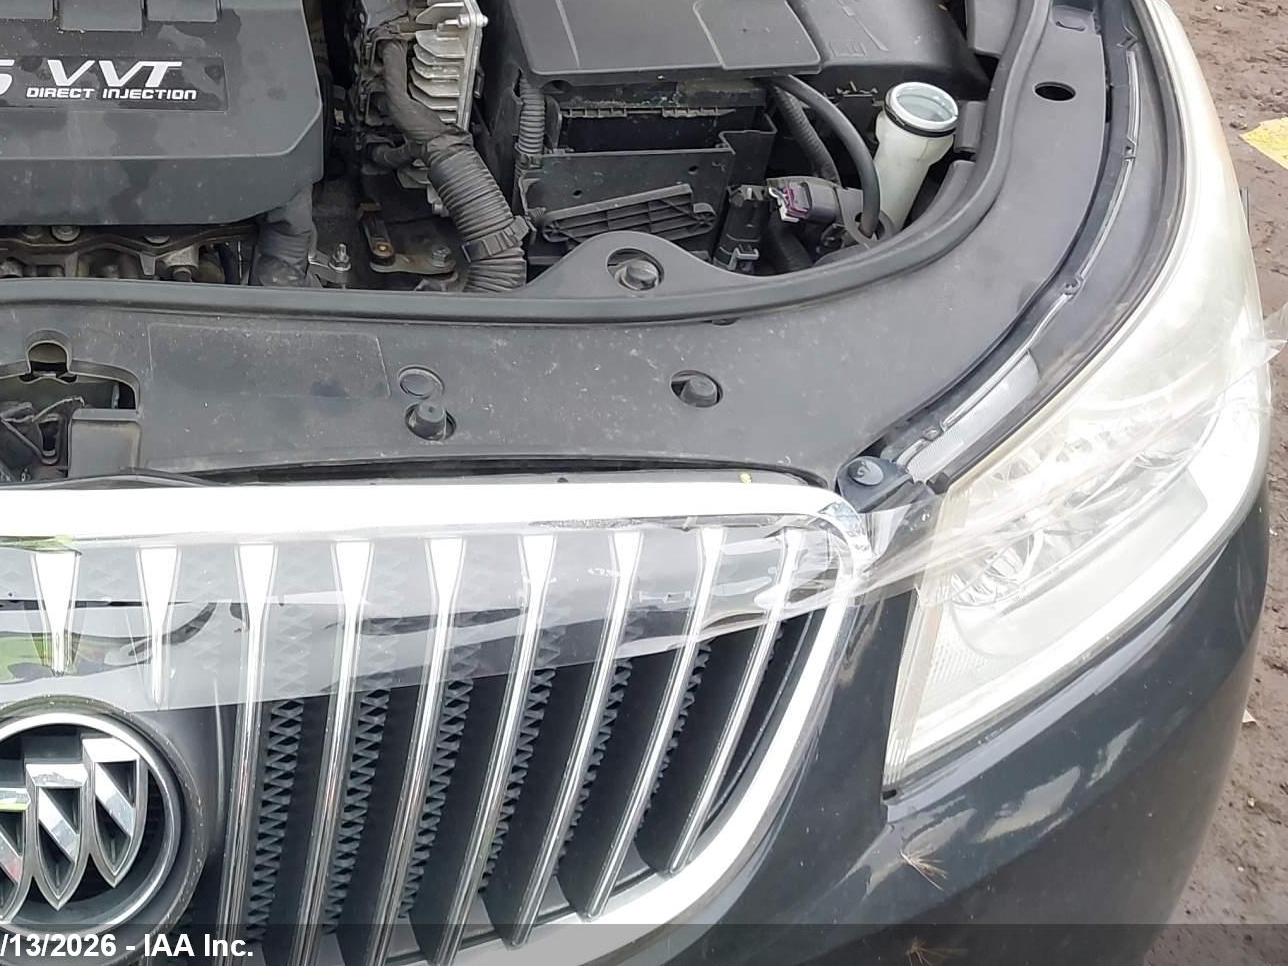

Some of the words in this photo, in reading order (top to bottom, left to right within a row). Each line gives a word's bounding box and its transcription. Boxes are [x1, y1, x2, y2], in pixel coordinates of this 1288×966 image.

[47, 59, 183, 88] VVT
[26, 87, 95, 99] DIRECT
[102, 88, 197, 101] INJECTION
